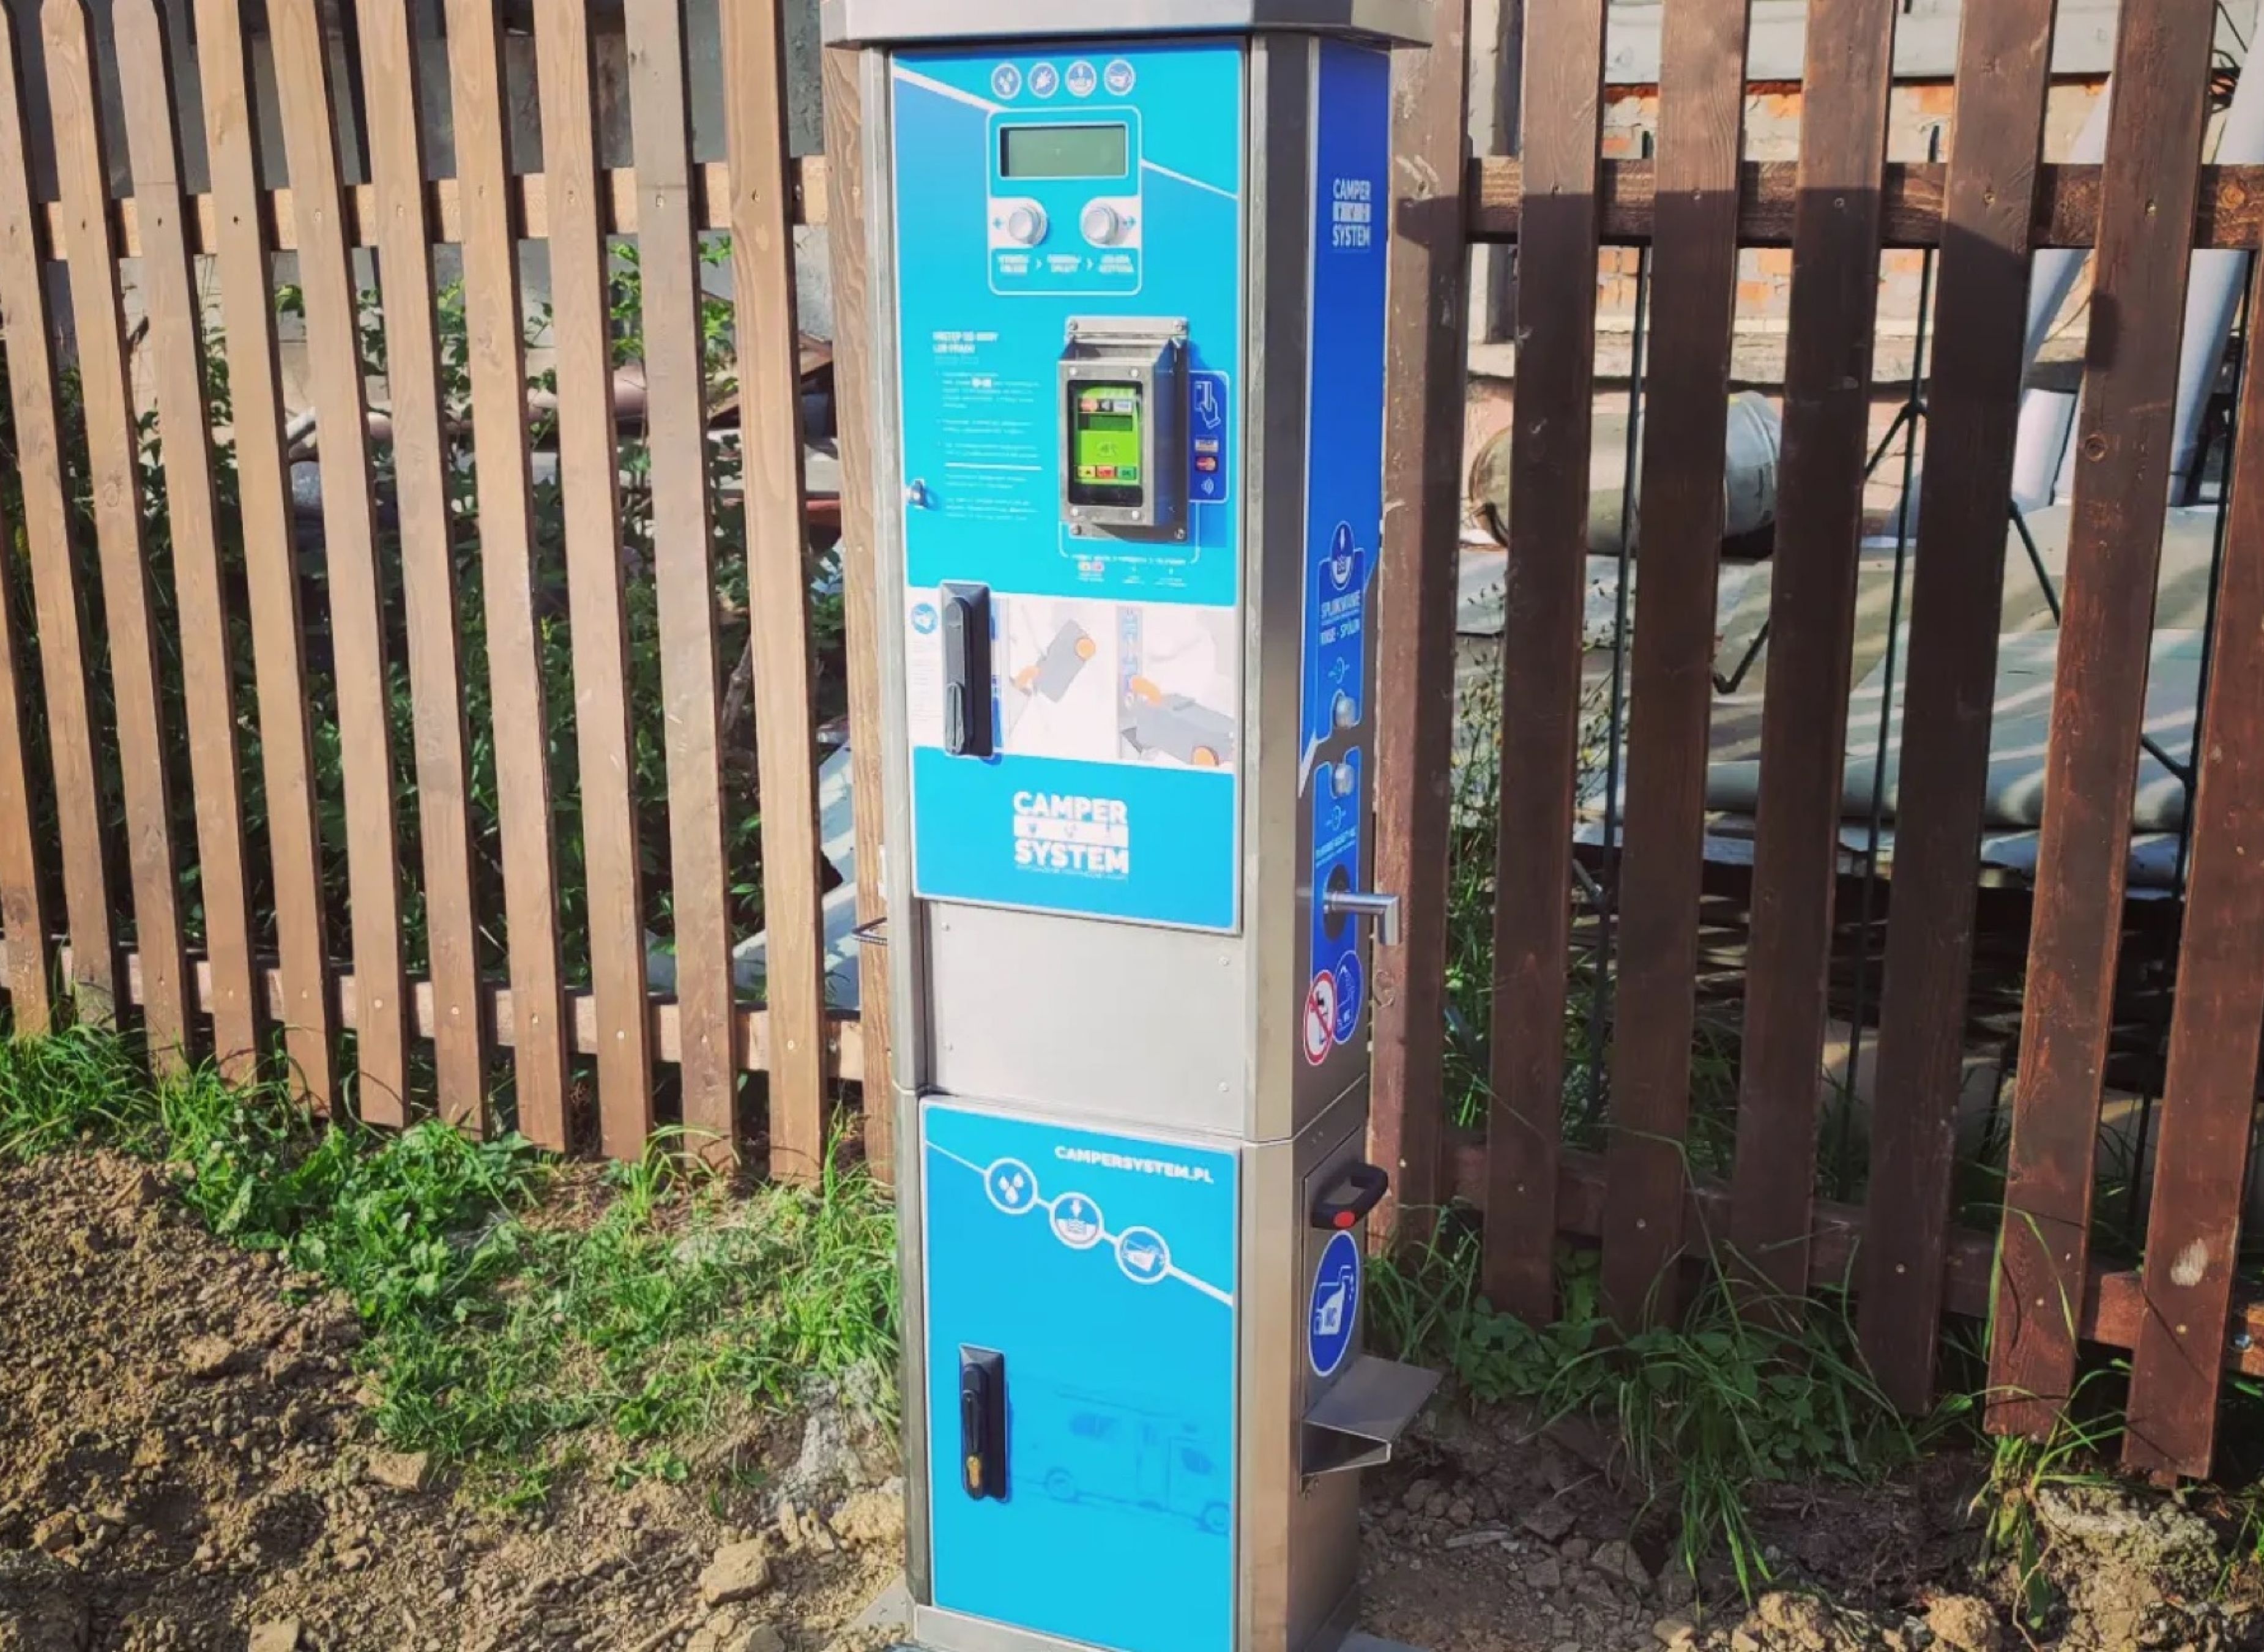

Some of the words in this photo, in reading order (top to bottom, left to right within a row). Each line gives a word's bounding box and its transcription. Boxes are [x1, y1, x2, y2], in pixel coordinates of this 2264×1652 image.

[1333, 178, 1371, 201] CAMPER
[1332, 223, 1371, 247] SYSTEM
[1013, 791, 1128, 825] CAMPER
[1014, 838, 1128, 874] SYSTEM
[1054, 1145, 1214, 1185] CAMPERSYSTEM.PL
